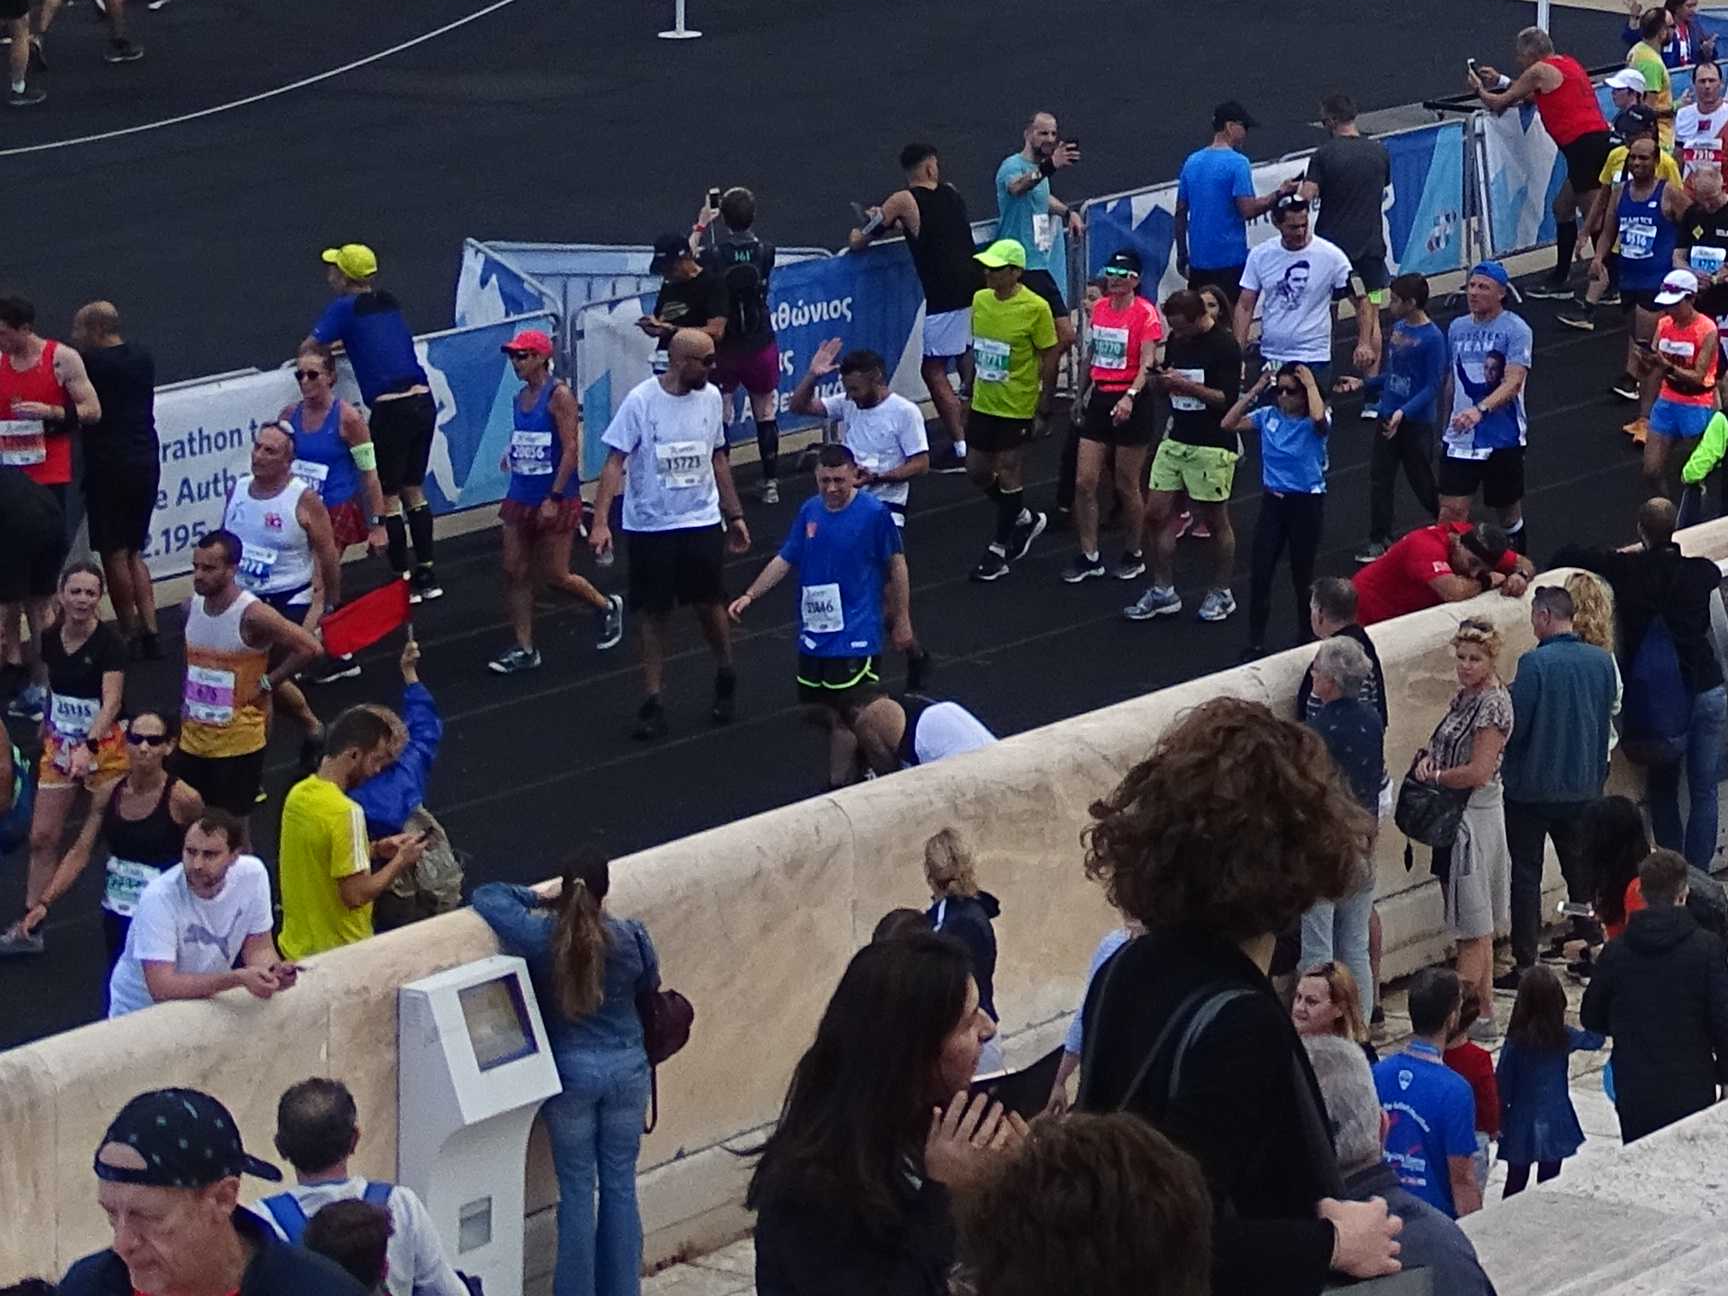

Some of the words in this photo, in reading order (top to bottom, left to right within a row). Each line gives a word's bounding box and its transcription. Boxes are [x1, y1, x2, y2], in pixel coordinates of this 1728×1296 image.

[1455, 340, 1495, 353] TEAM
[162, 426, 244, 463] rathon
[142, 521, 208, 559] 2.195
